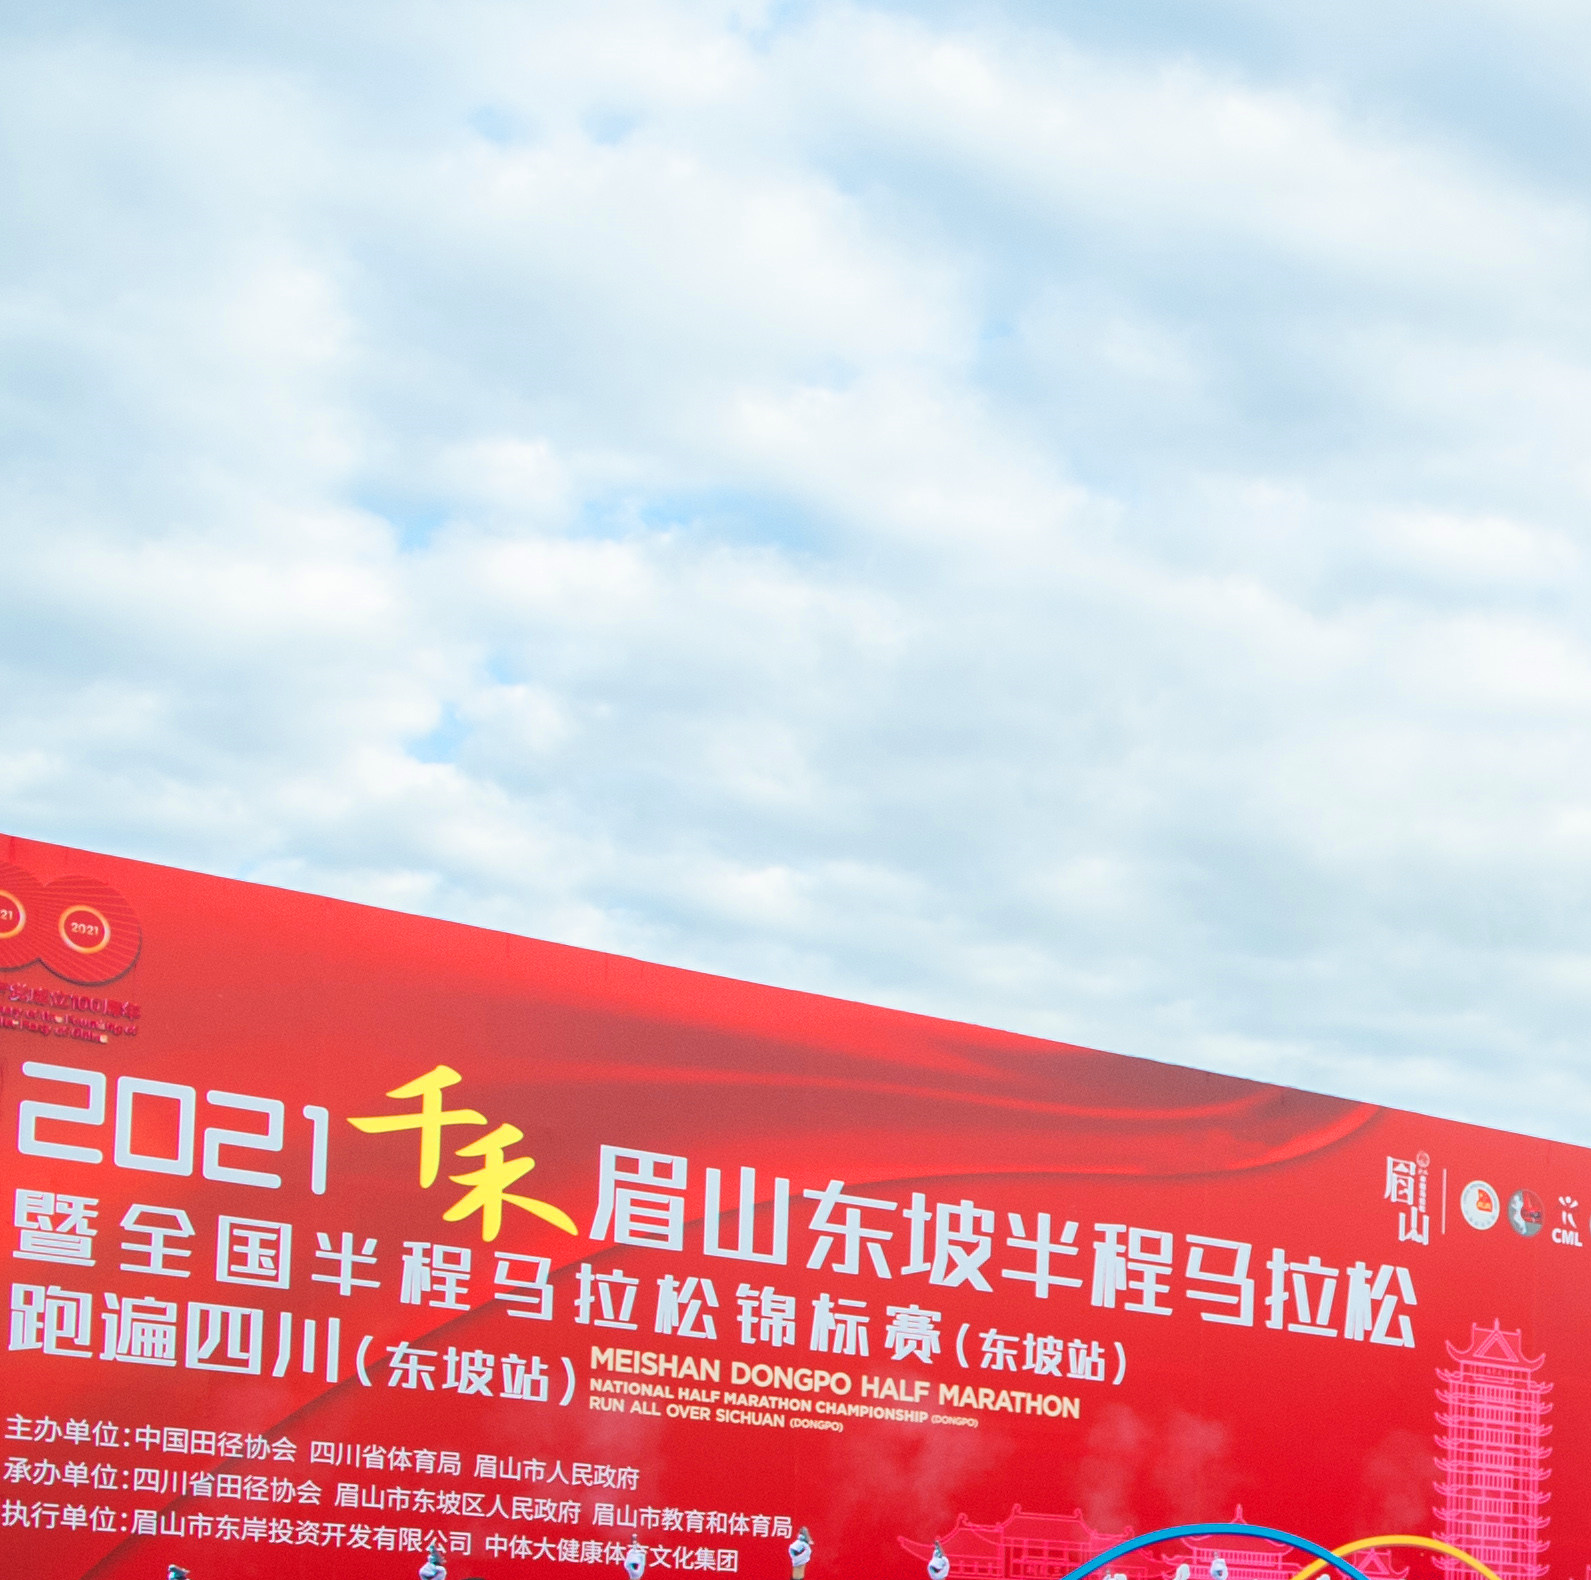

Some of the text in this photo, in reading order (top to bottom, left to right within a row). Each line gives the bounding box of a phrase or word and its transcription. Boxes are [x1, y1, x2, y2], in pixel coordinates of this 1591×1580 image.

[71, 921, 99, 936] 2021
[16, 1060, 1419, 1350] 2021 千禾 眉山东坡半程马拉松
[1551, 1228, 1583, 1247] CML
[8, 1282, 577, 1408] 跑遍四川(东坡站)
[590, 1345, 1081, 1420] MEISHAN DONGPO HALF MARATHON
[589, 1378, 979, 1429] NATIONAL HALF MARATHON CHAMPIONSHIP (DONGPO)
[589, 1396, 844, 1433] RUN ALL OVER SICHUAN (DONGPO)
[4, 1413, 640, 1491] 主办单位:中国田径协会 四川省体育局 眉山市人民政府
[3, 1456, 794, 1540] 承办单位:四川省田径协会 眉山市东坡区人民政府 眉山市教育和体育局
